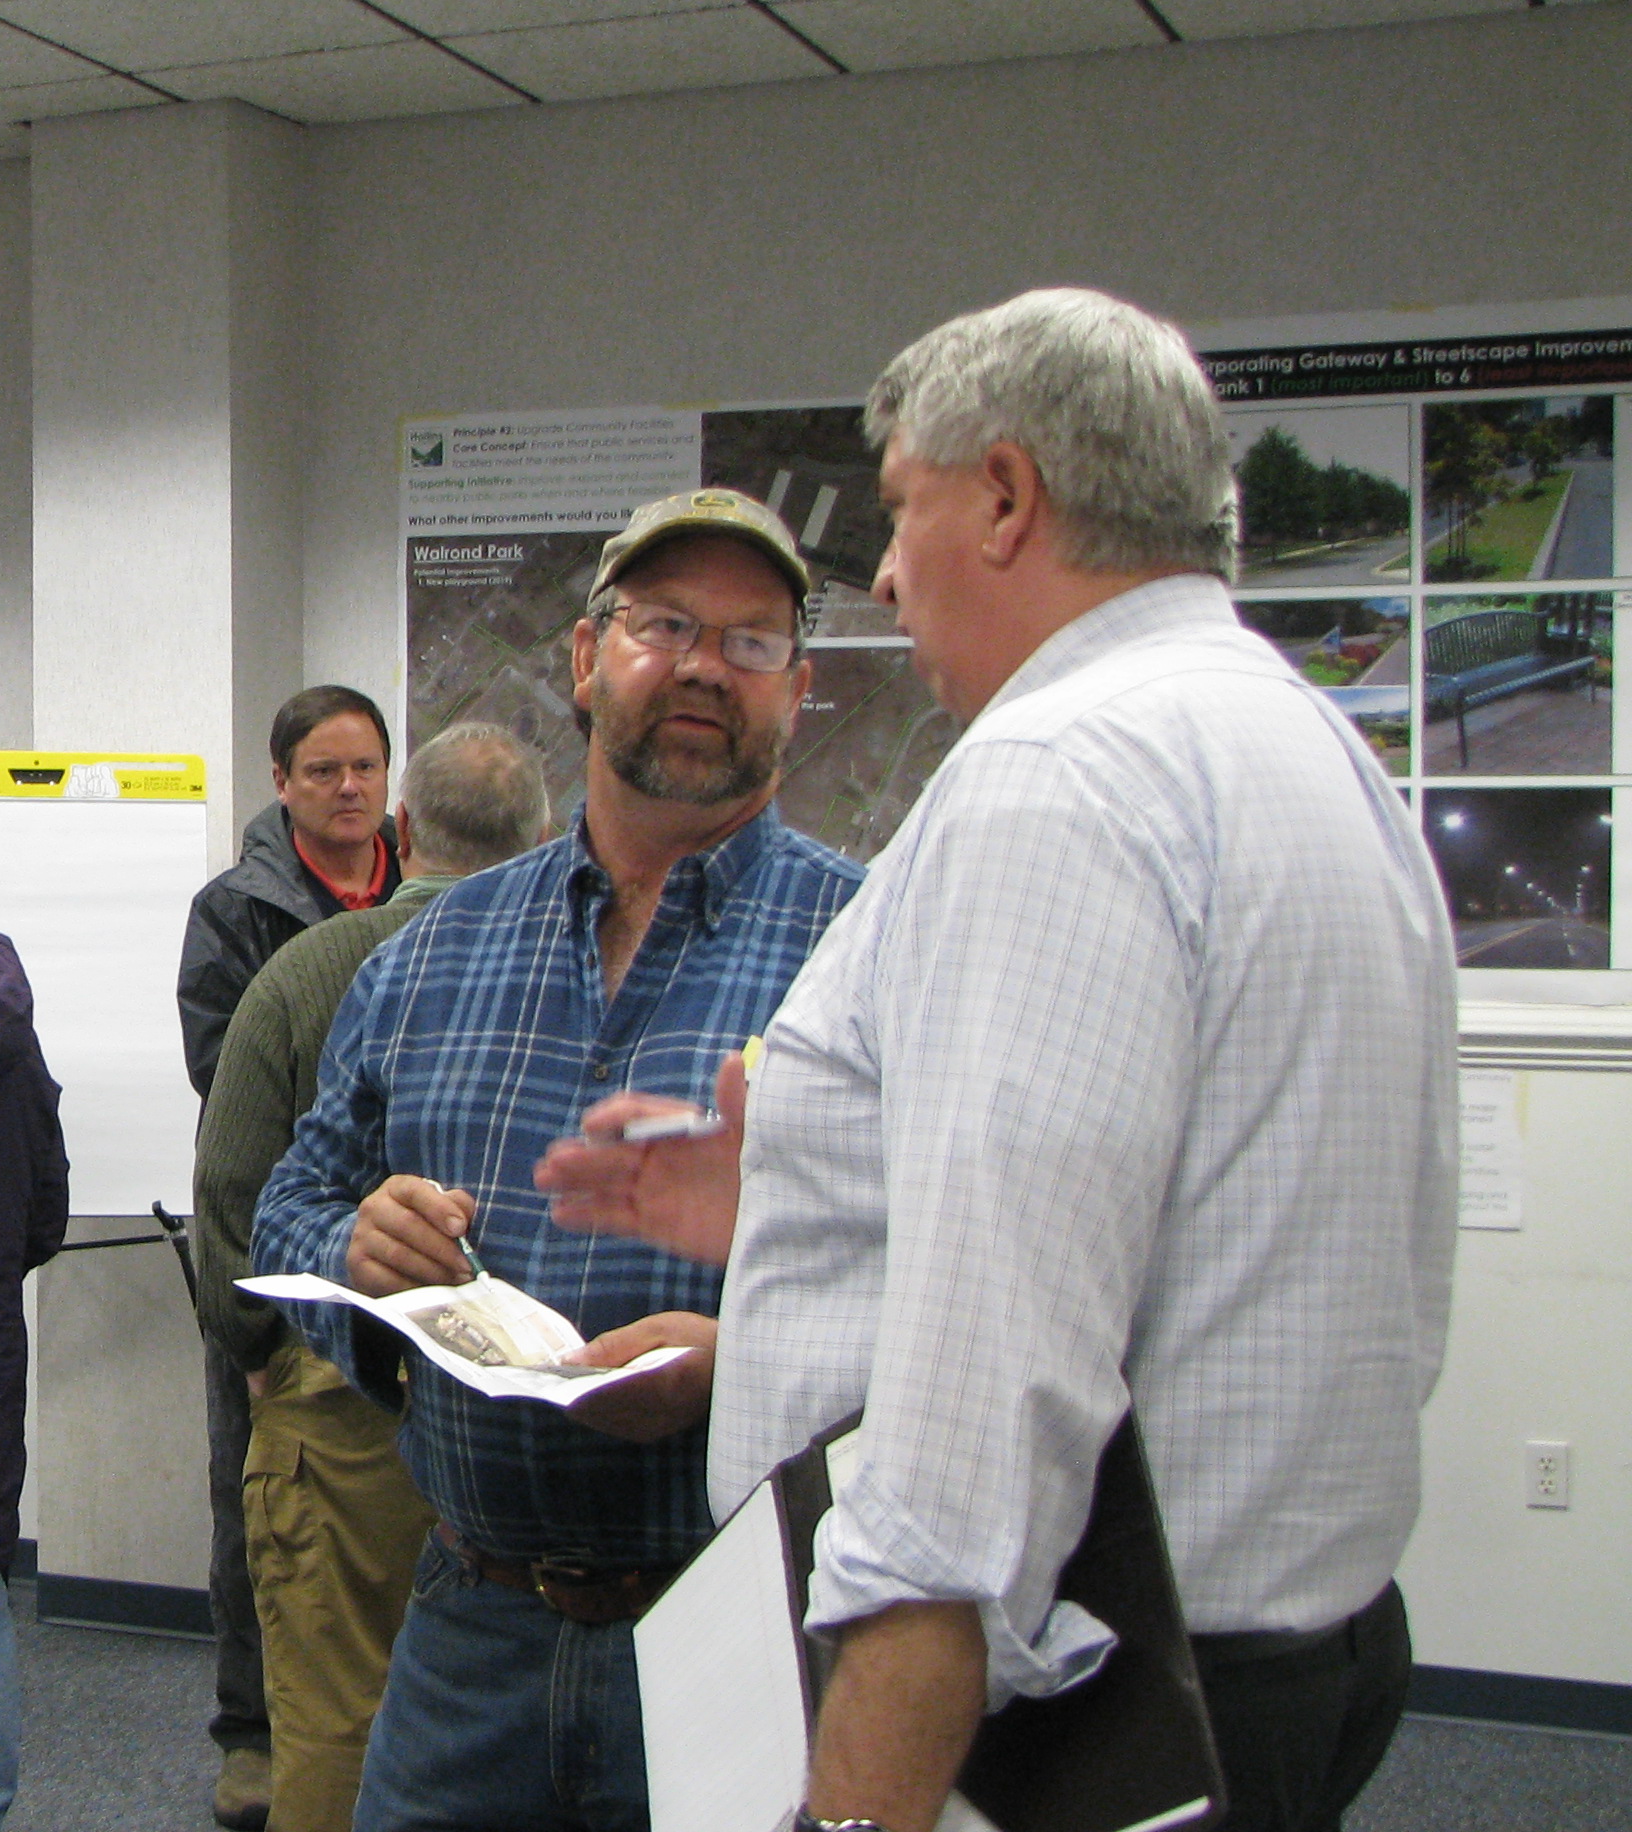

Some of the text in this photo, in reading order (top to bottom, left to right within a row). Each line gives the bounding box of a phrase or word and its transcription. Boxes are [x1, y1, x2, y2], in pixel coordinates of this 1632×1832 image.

[1298, 351, 1387, 369] Gateway
[1393, 350, 1405, 365] &
[1412, 344, 1529, 362] Streetscape
[1256, 378, 1263, 394] 1
[1435, 367, 1454, 385] to
[1459, 367, 1472, 384] 6
[452, 426, 497, 439] Principle
[517, 424, 563, 437] Upgrade
[566, 421, 626, 434] Community
[452, 442, 477, 453] Core
[531, 439, 564, 450] Ensure
[567, 438, 589, 448] that
[592, 437, 624, 450] public
[671, 434, 694, 445] and
[495, 457, 522, 467] meet
[408, 477, 464, 489] Supporting
[408, 514, 436, 526] What
[439, 514, 468, 525] other
[471, 511, 553, 525] improvements
[556, 510, 592, 521] would
[596, 512, 617, 522] you
[414, 543, 524, 561] Walrond Park
[121, 780, 132, 790] 30
